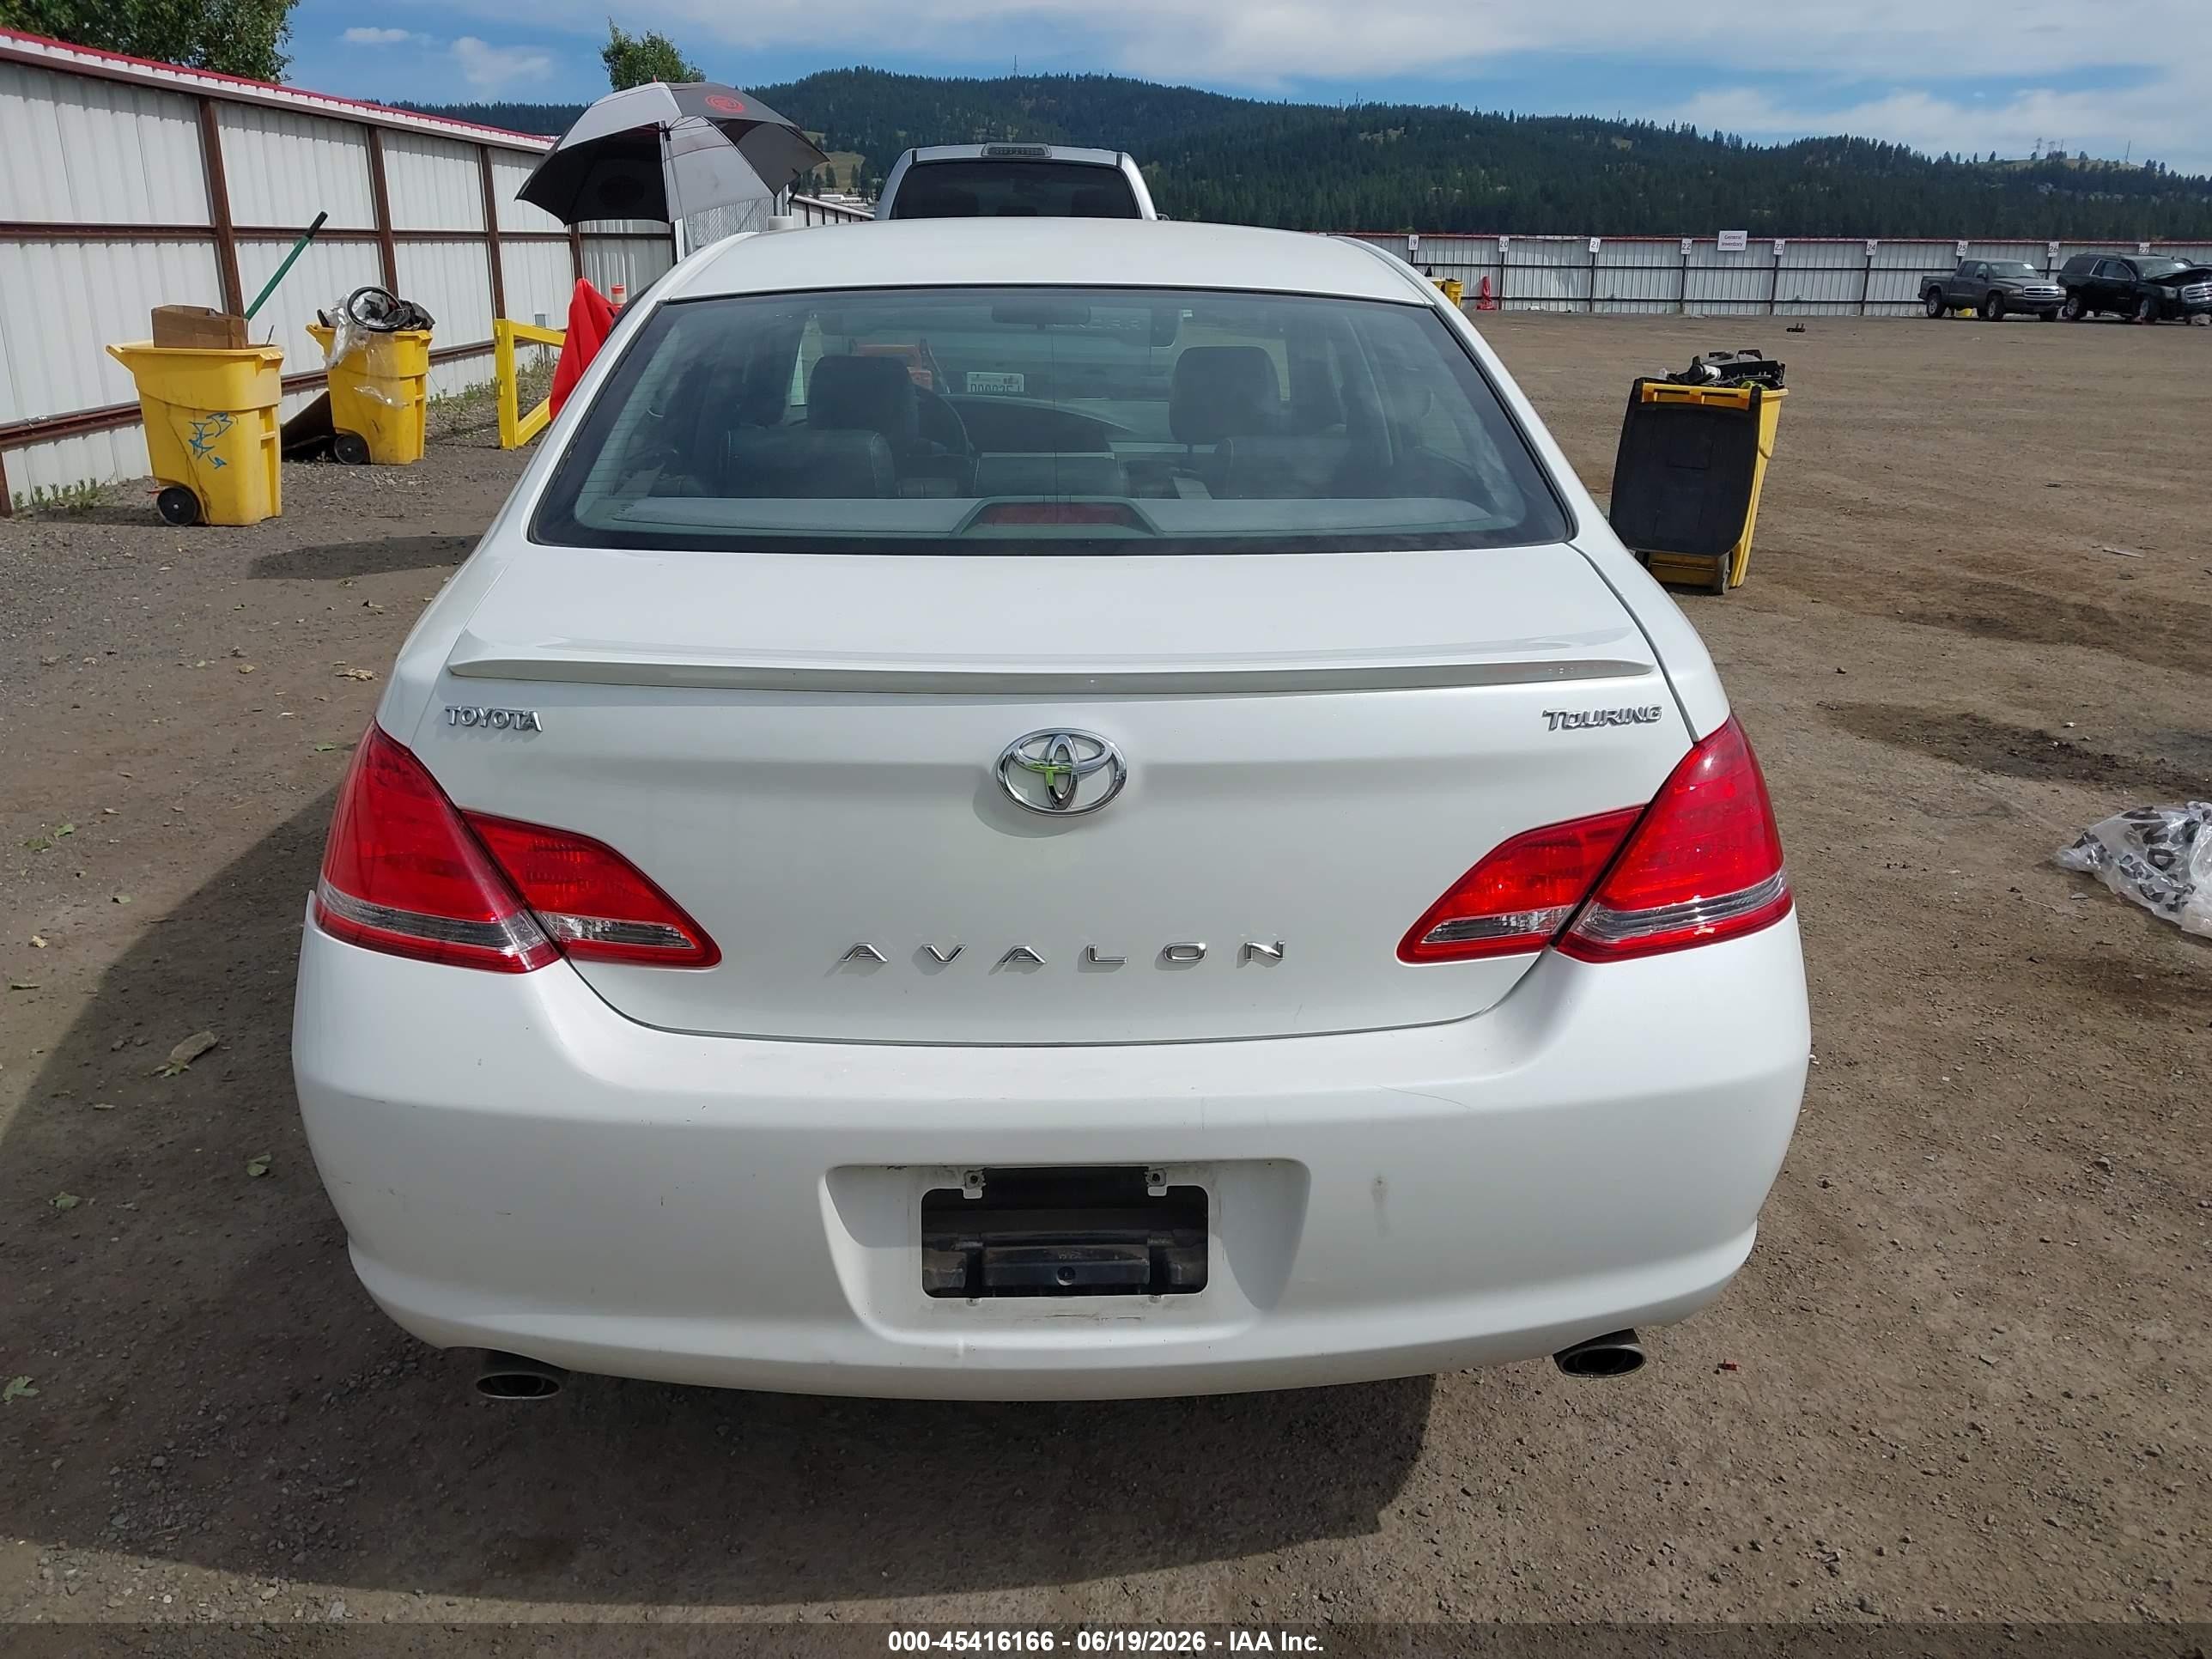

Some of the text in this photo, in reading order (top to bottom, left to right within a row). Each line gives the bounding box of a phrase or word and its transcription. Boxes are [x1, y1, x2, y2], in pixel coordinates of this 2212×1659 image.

[445, 705, 543, 732] TOYOTA
[1542, 706, 1662, 731] TOURING
[839, 940, 1285, 964] AVALON
